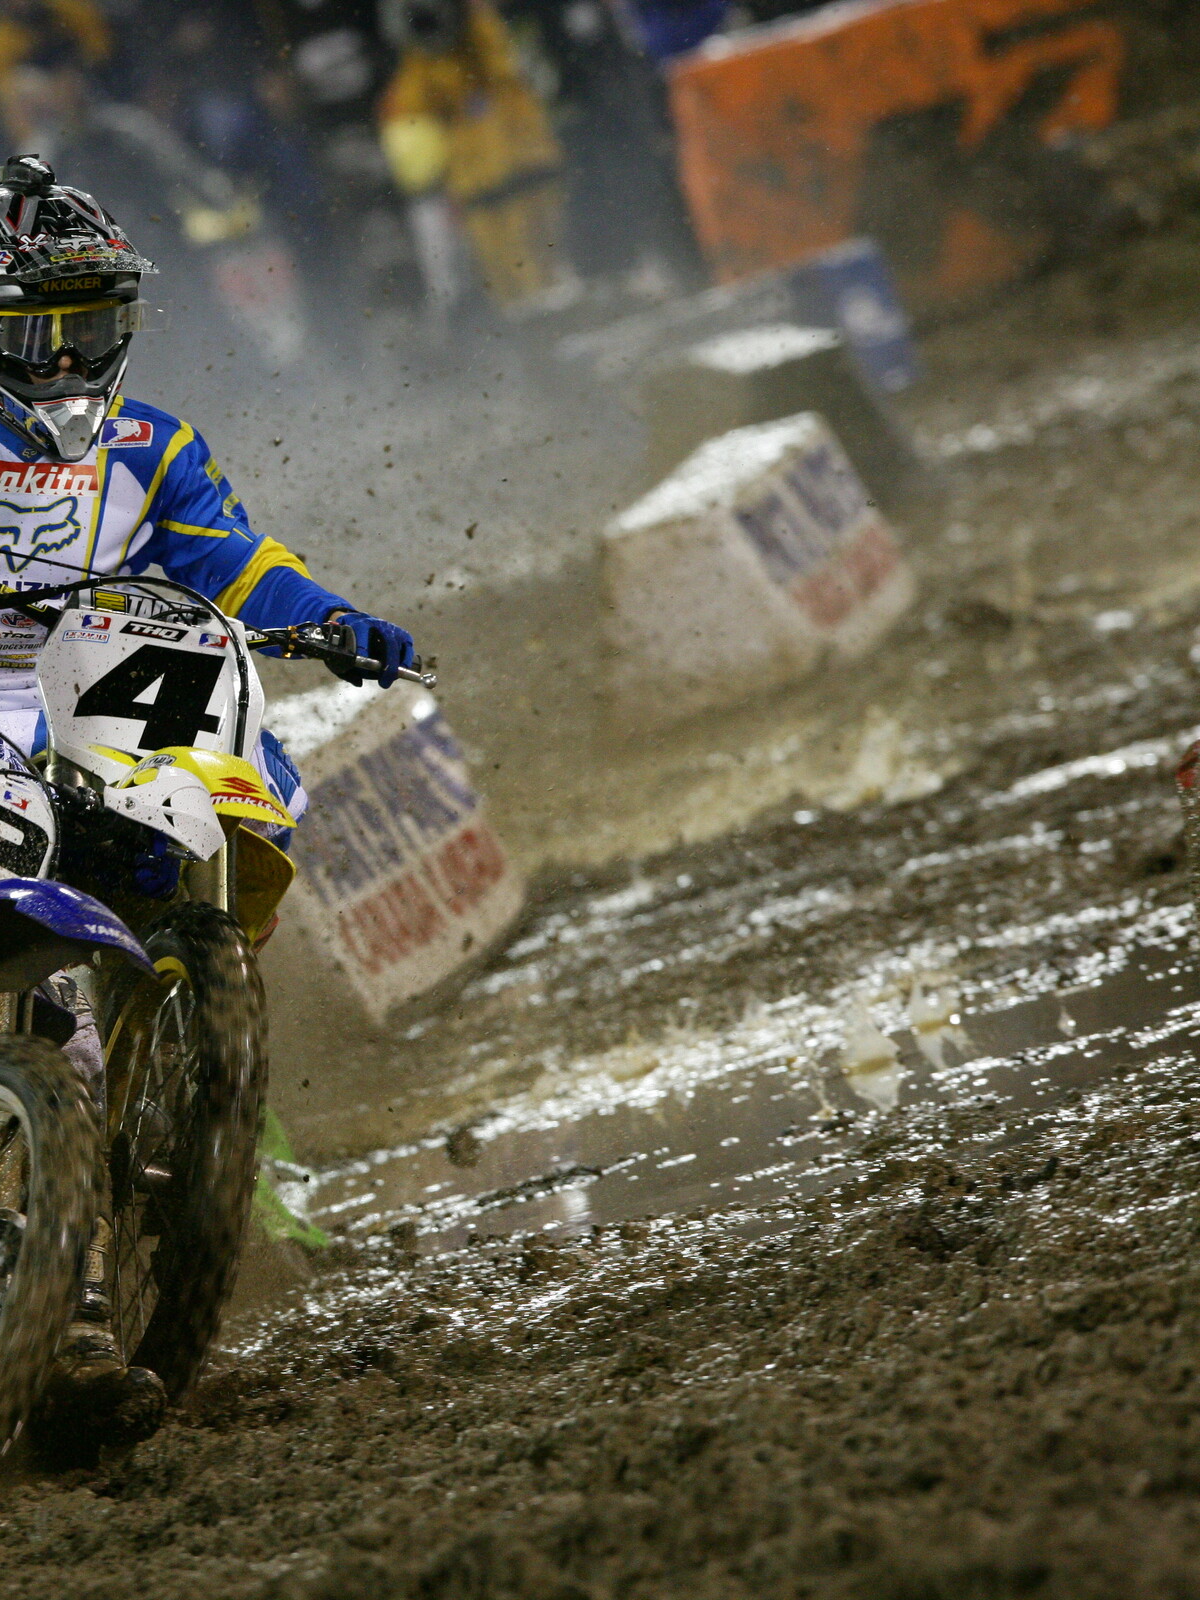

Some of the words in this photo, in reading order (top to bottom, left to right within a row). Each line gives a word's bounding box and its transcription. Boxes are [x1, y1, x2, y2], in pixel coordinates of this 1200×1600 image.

[50, 276, 102, 292] KICKER
[2, 630, 37, 639] TAG
[128, 623, 184, 641] THQ
[73, 644, 226, 752] 4
